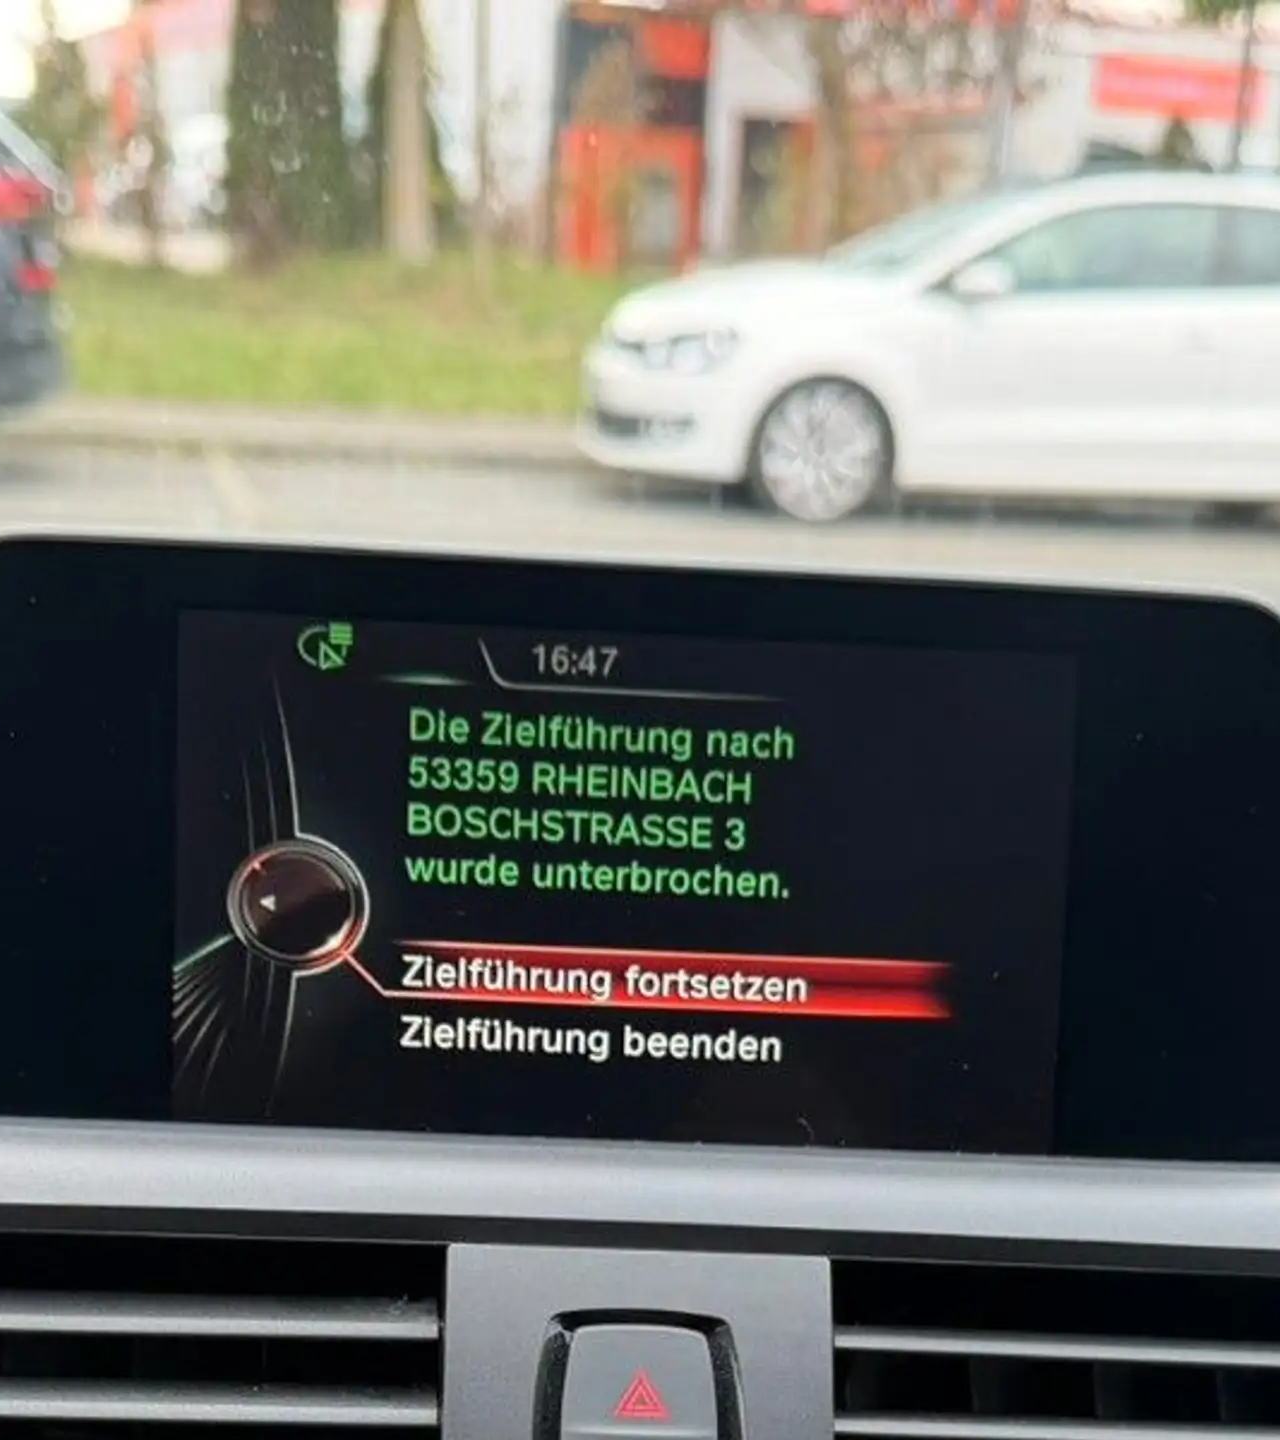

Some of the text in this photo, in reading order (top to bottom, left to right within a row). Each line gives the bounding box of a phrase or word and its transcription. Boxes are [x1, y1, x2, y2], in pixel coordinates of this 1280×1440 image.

[532, 644, 619, 678] 16:47
[409, 707, 795, 761] Die Zielführung nach
[408, 755, 752, 804] 53359 RHEINBACH
[407, 804, 747, 851] BOSCHSTRASSE 3
[405, 852, 790, 900] wurde unterbrochen.
[401, 954, 808, 1005] Zielführung fortsetzen
[399, 1014, 783, 1063] Zielführung beenden
